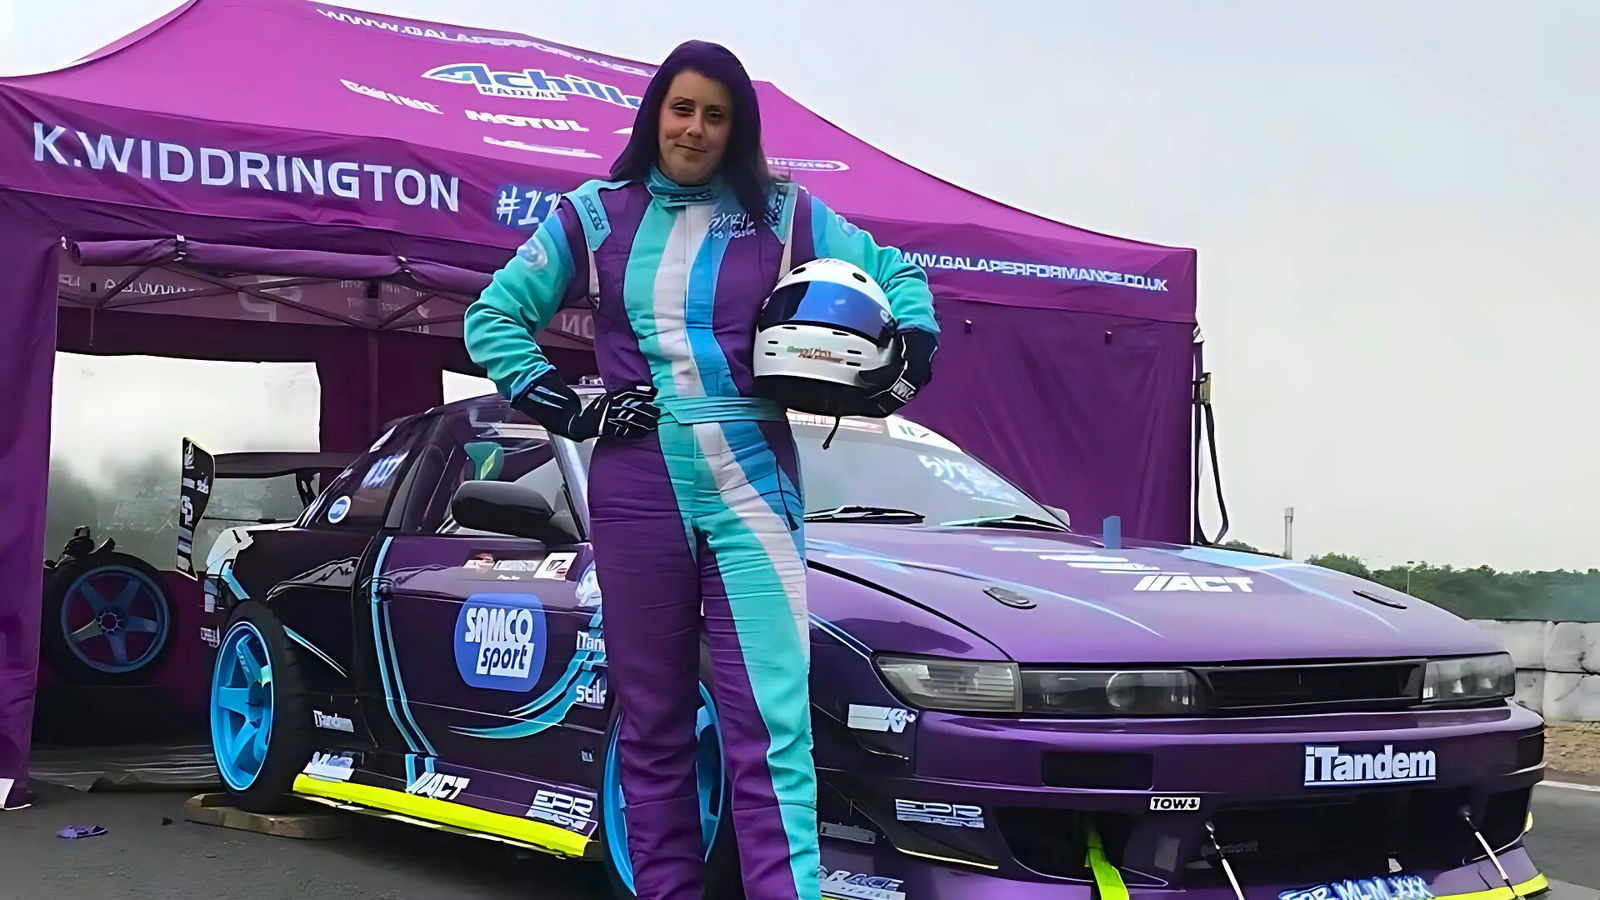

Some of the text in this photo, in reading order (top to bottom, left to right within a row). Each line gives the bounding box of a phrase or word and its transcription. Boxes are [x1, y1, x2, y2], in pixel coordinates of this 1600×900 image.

[464, 109, 590, 132] MOTUL
[33, 122, 460, 212] K.WIDDRINGTON
[465, 607, 534, 644] SAMCO
[1304, 744, 1437, 783] iTandem
[1153, 798, 1189, 810] TOW
